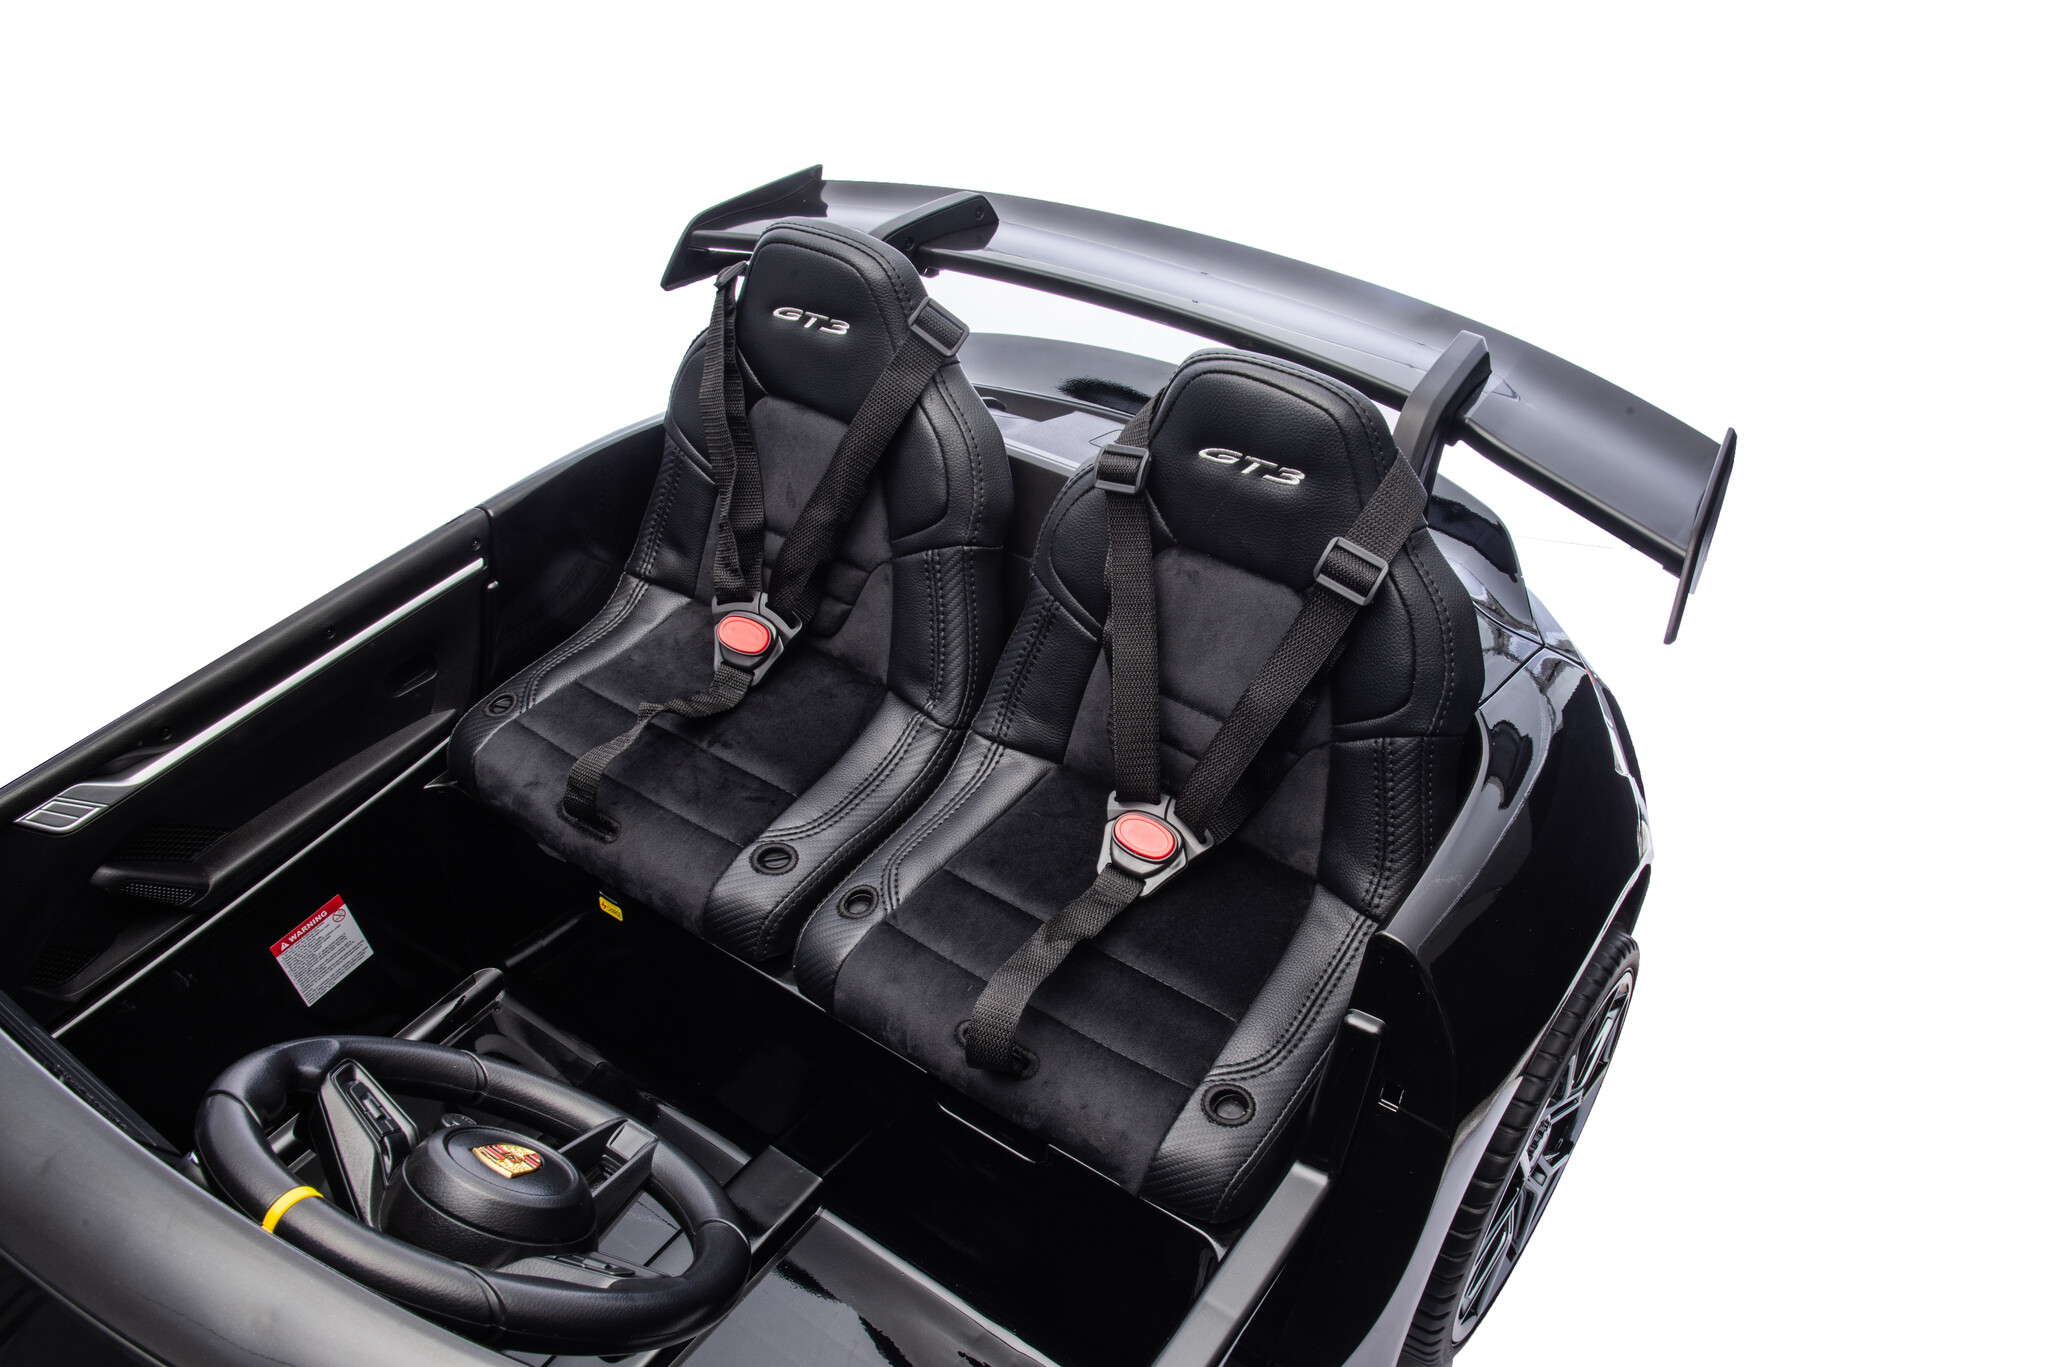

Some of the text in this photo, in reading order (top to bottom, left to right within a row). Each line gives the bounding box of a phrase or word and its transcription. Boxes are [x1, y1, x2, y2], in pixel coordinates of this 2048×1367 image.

[773, 307, 850, 335] GT3
[1199, 448, 1305, 486] GT3
[288, 910, 328, 942] WARNING
